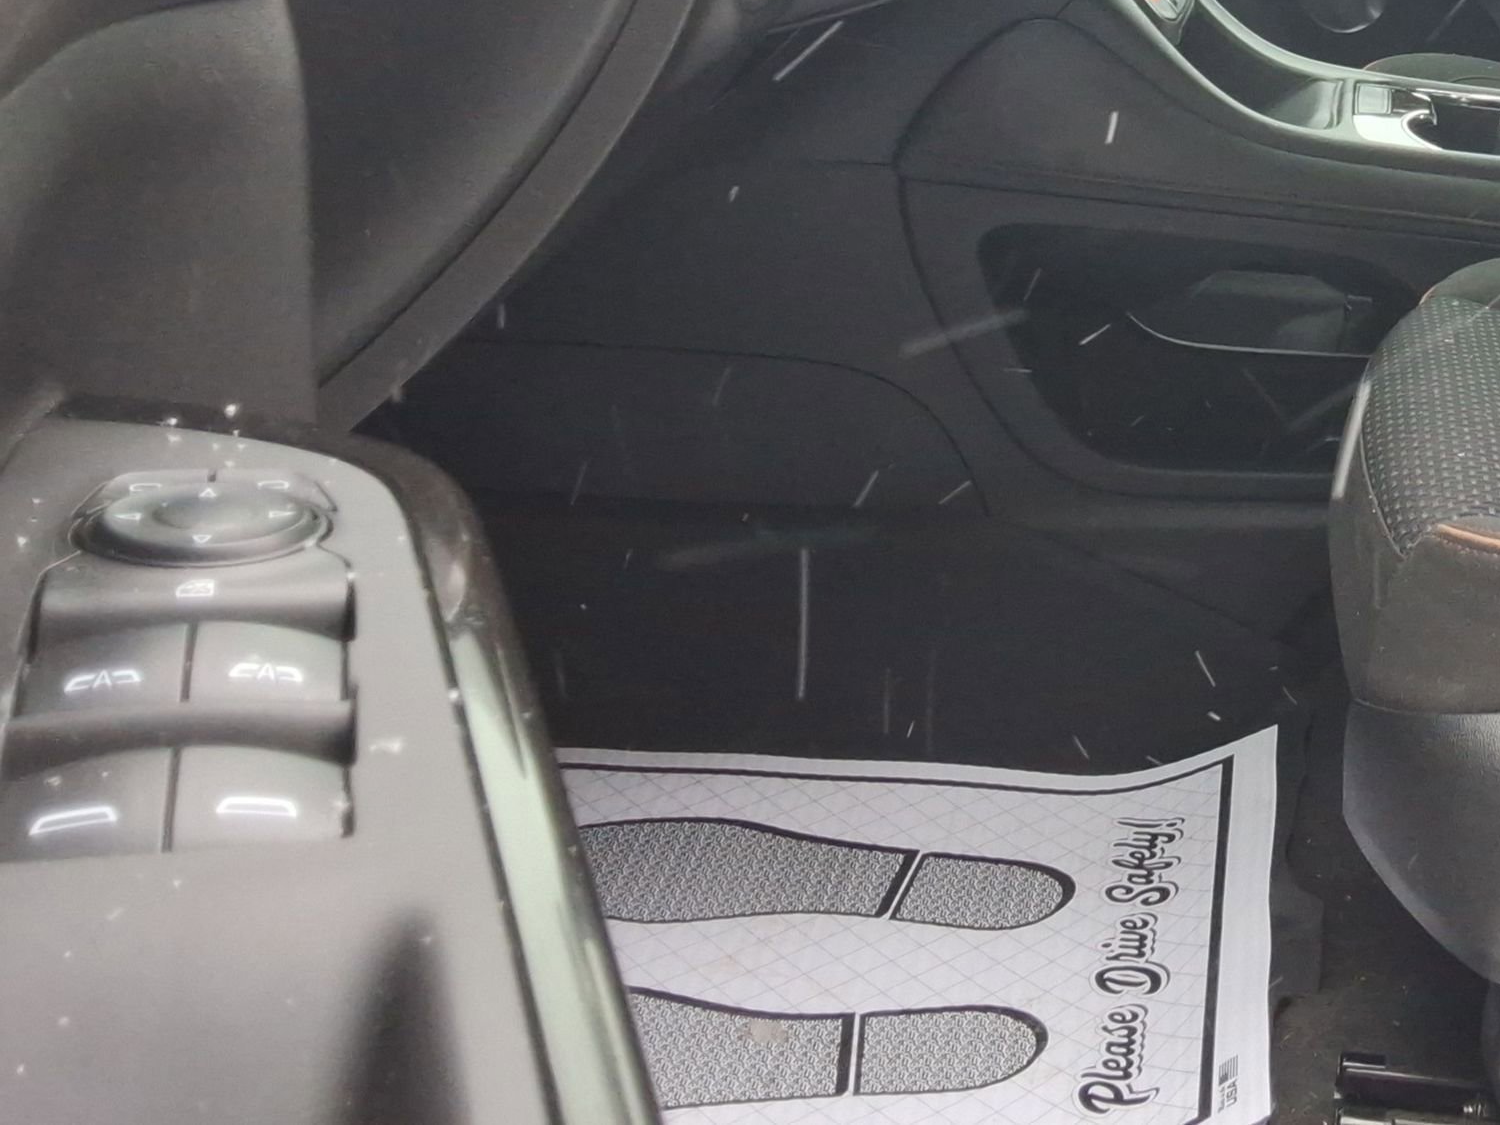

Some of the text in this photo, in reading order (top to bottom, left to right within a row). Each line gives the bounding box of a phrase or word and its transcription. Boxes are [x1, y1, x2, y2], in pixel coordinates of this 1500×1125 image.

[1078, 816, 1185, 1114] Please Drive Safely!
[1225, 1078, 1238, 1108] USA
